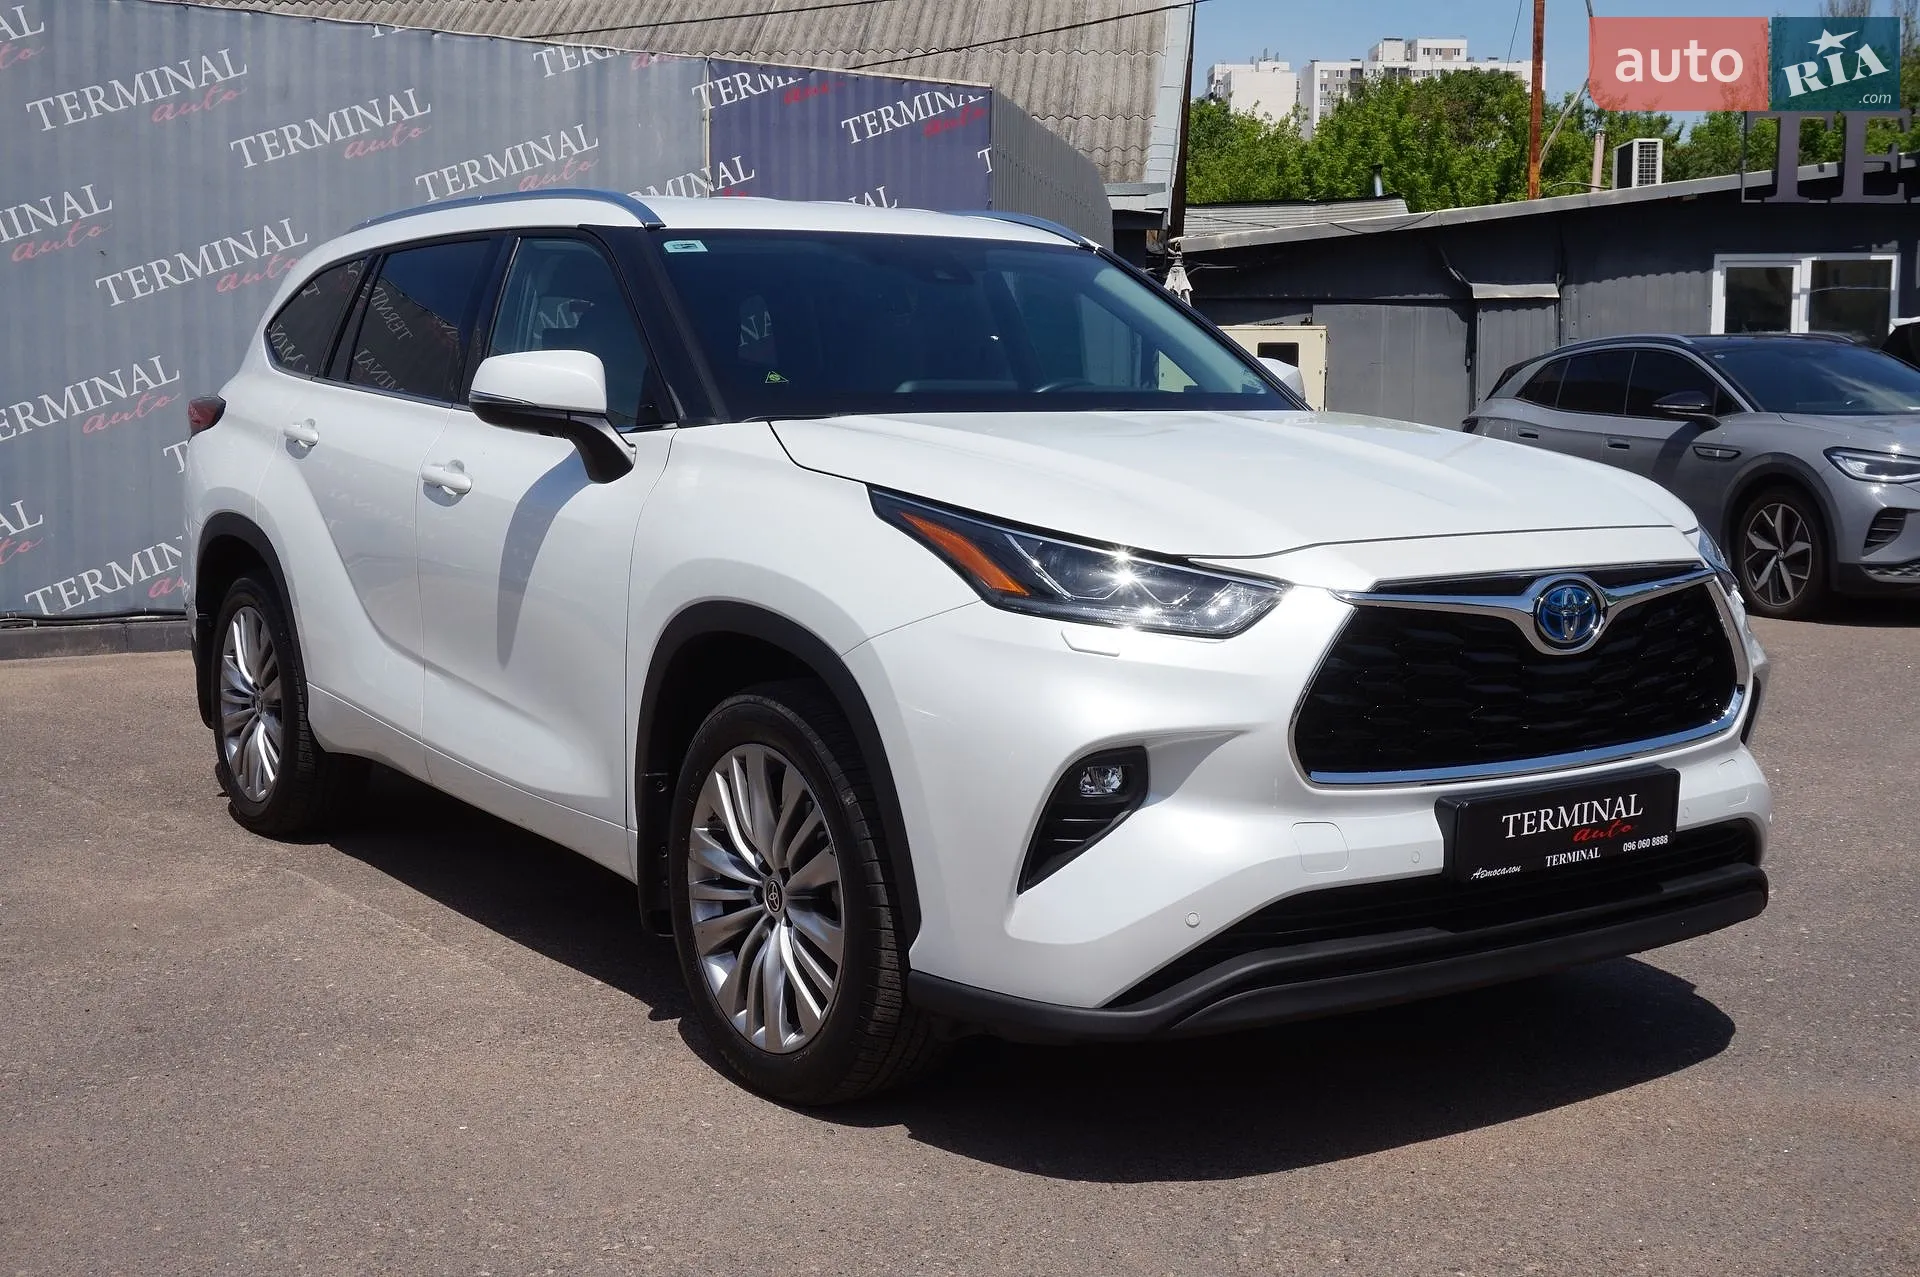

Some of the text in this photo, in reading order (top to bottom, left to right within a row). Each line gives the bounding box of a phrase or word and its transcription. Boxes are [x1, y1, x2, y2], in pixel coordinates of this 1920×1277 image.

[26, 48, 248, 132] TERMINAL
[151, 84, 249, 124] auto
[230, 88, 431, 169] TERMINAL
[841, 91, 985, 144] TERMIN
[344, 124, 433, 160] auto
[415, 123, 599, 202] TERMINAL
[518, 158, 602, 192] auto
[11, 219, 113, 263] auto
[95, 217, 309, 307] TERMINAL
[82, 392, 182, 435] auto
[1502, 794, 1643, 838] TERMINAL
[1572, 818, 1637, 843] auto
[1545, 848, 1601, 867] TERMINAL
[1623, 834, 1669, 852] 096 060 8888
